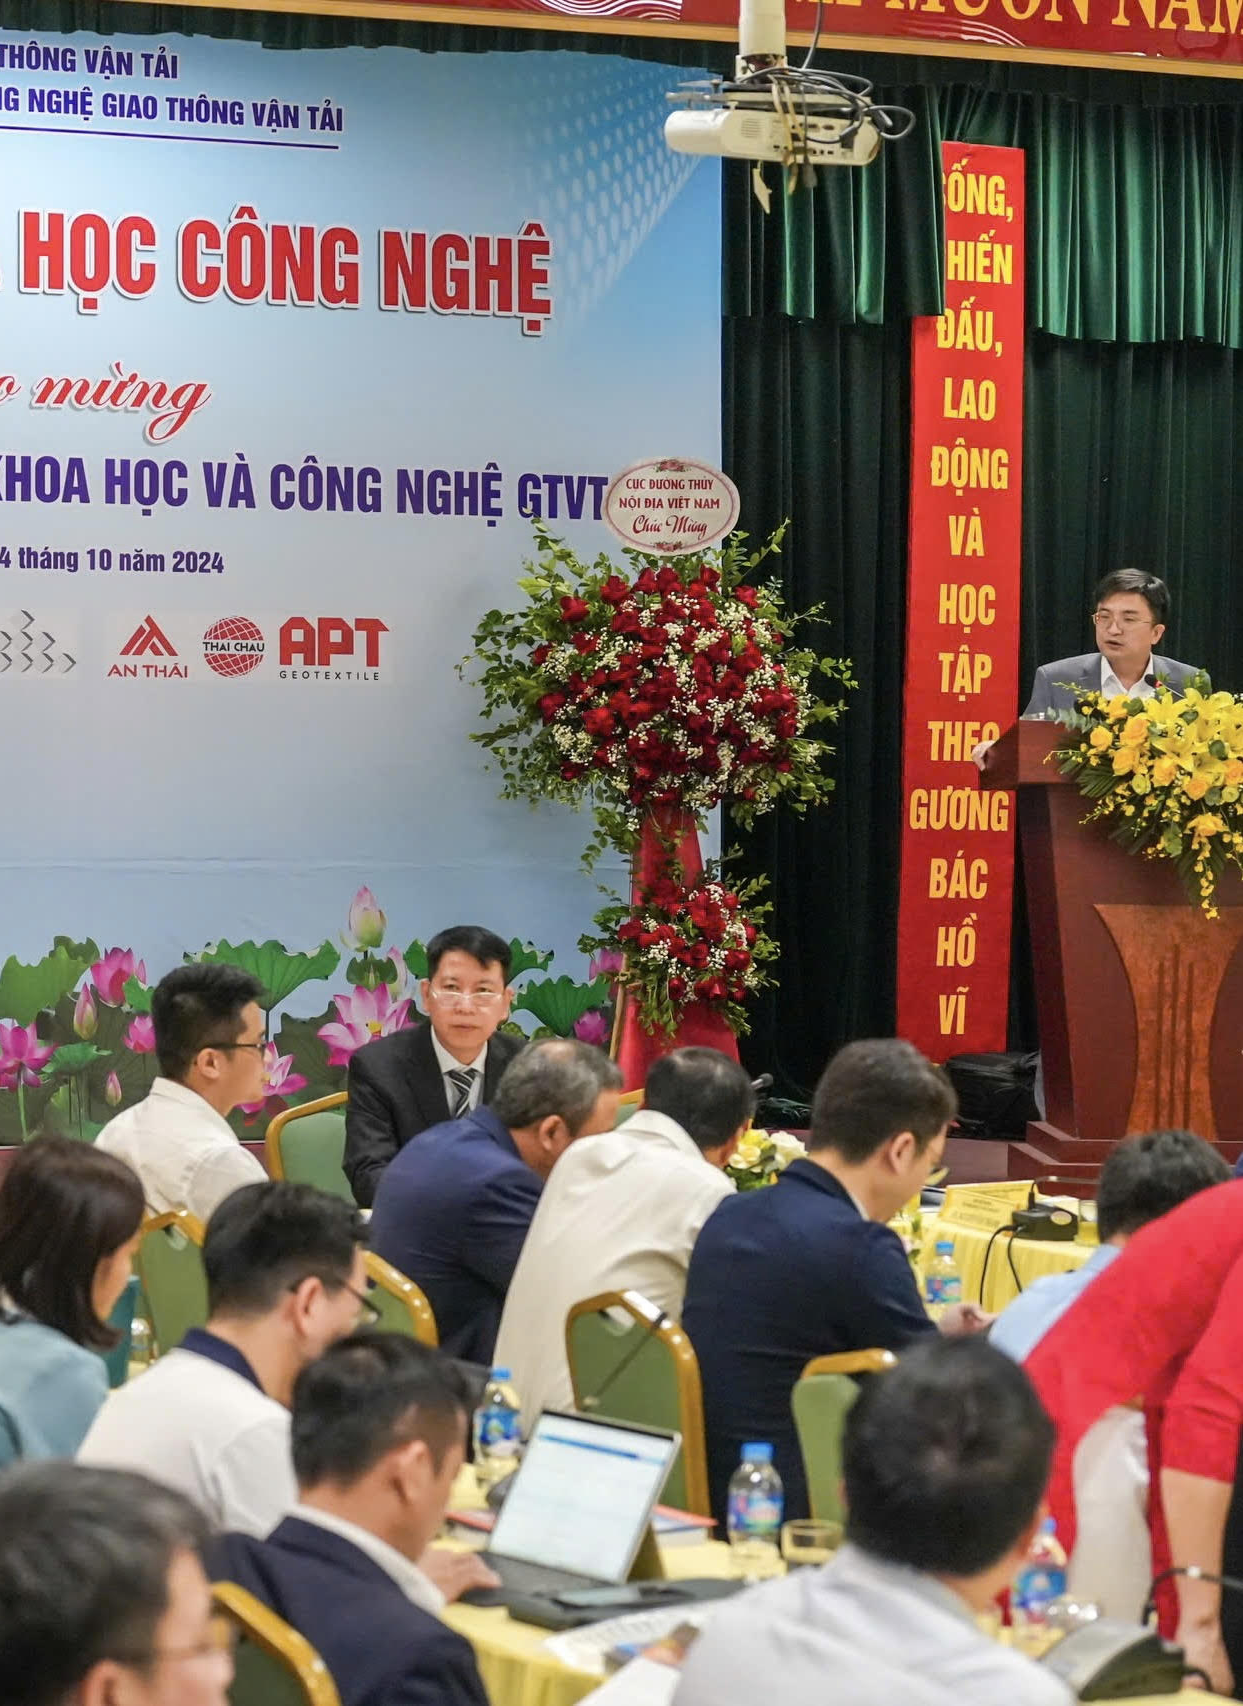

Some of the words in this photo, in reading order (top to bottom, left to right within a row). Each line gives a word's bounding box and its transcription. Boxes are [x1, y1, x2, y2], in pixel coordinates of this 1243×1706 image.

[85, 46, 134, 80] VẬN
[141, 46, 179, 80] TẢI
[29, 87, 95, 121] NGHỆ
[103, 93, 159, 120] GIAO
[166, 94, 246, 126] THÔNG
[253, 99, 301, 133] VẬN
[307, 99, 344, 131] TẢI
[23, 210, 158, 311] HỌC
[181, 205, 360, 306] CÔNG
[382, 222, 553, 333] NGHỆ
[947, 229, 1013, 285] HIẾN
[936, 296, 1003, 357] ĐẤU,
[35, 360, 212, 441] mừng
[942, 377, 997, 422] LAO
[104, 458, 189, 517] HỌC
[203, 453, 257, 510] VÀ
[270, 456, 383, 514] CÔNG
[397, 462, 504, 528] NGHỆ
[517, 473, 609, 520] GTVT
[930, 437, 1010, 497] ĐỘNG
[619, 496, 641, 511] NỘI
[644, 498, 664, 511] ĐỊA
[667, 496, 692, 511] VIỆT
[693, 498, 720, 510] NAM
[632, 514, 663, 535] Chúc
[948, 507, 985, 557] VÀ
[17, 546, 79, 573] tháng
[86, 549, 113, 571] 10
[118, 548, 165, 572] năm
[171, 551, 225, 574] 2024
[938, 583, 996, 633] HỌC
[279, 616, 389, 668] APT
[107, 663, 138, 677] AN
[279, 670, 380, 681] GEOTEXTILE
[938, 644, 993, 702] TẬP
[909, 785, 1009, 832] GƯƠNG
[928, 850, 988, 900] BÁC
[936, 912, 978, 967] HỒ
[939, 986, 970, 1035] VĨ
